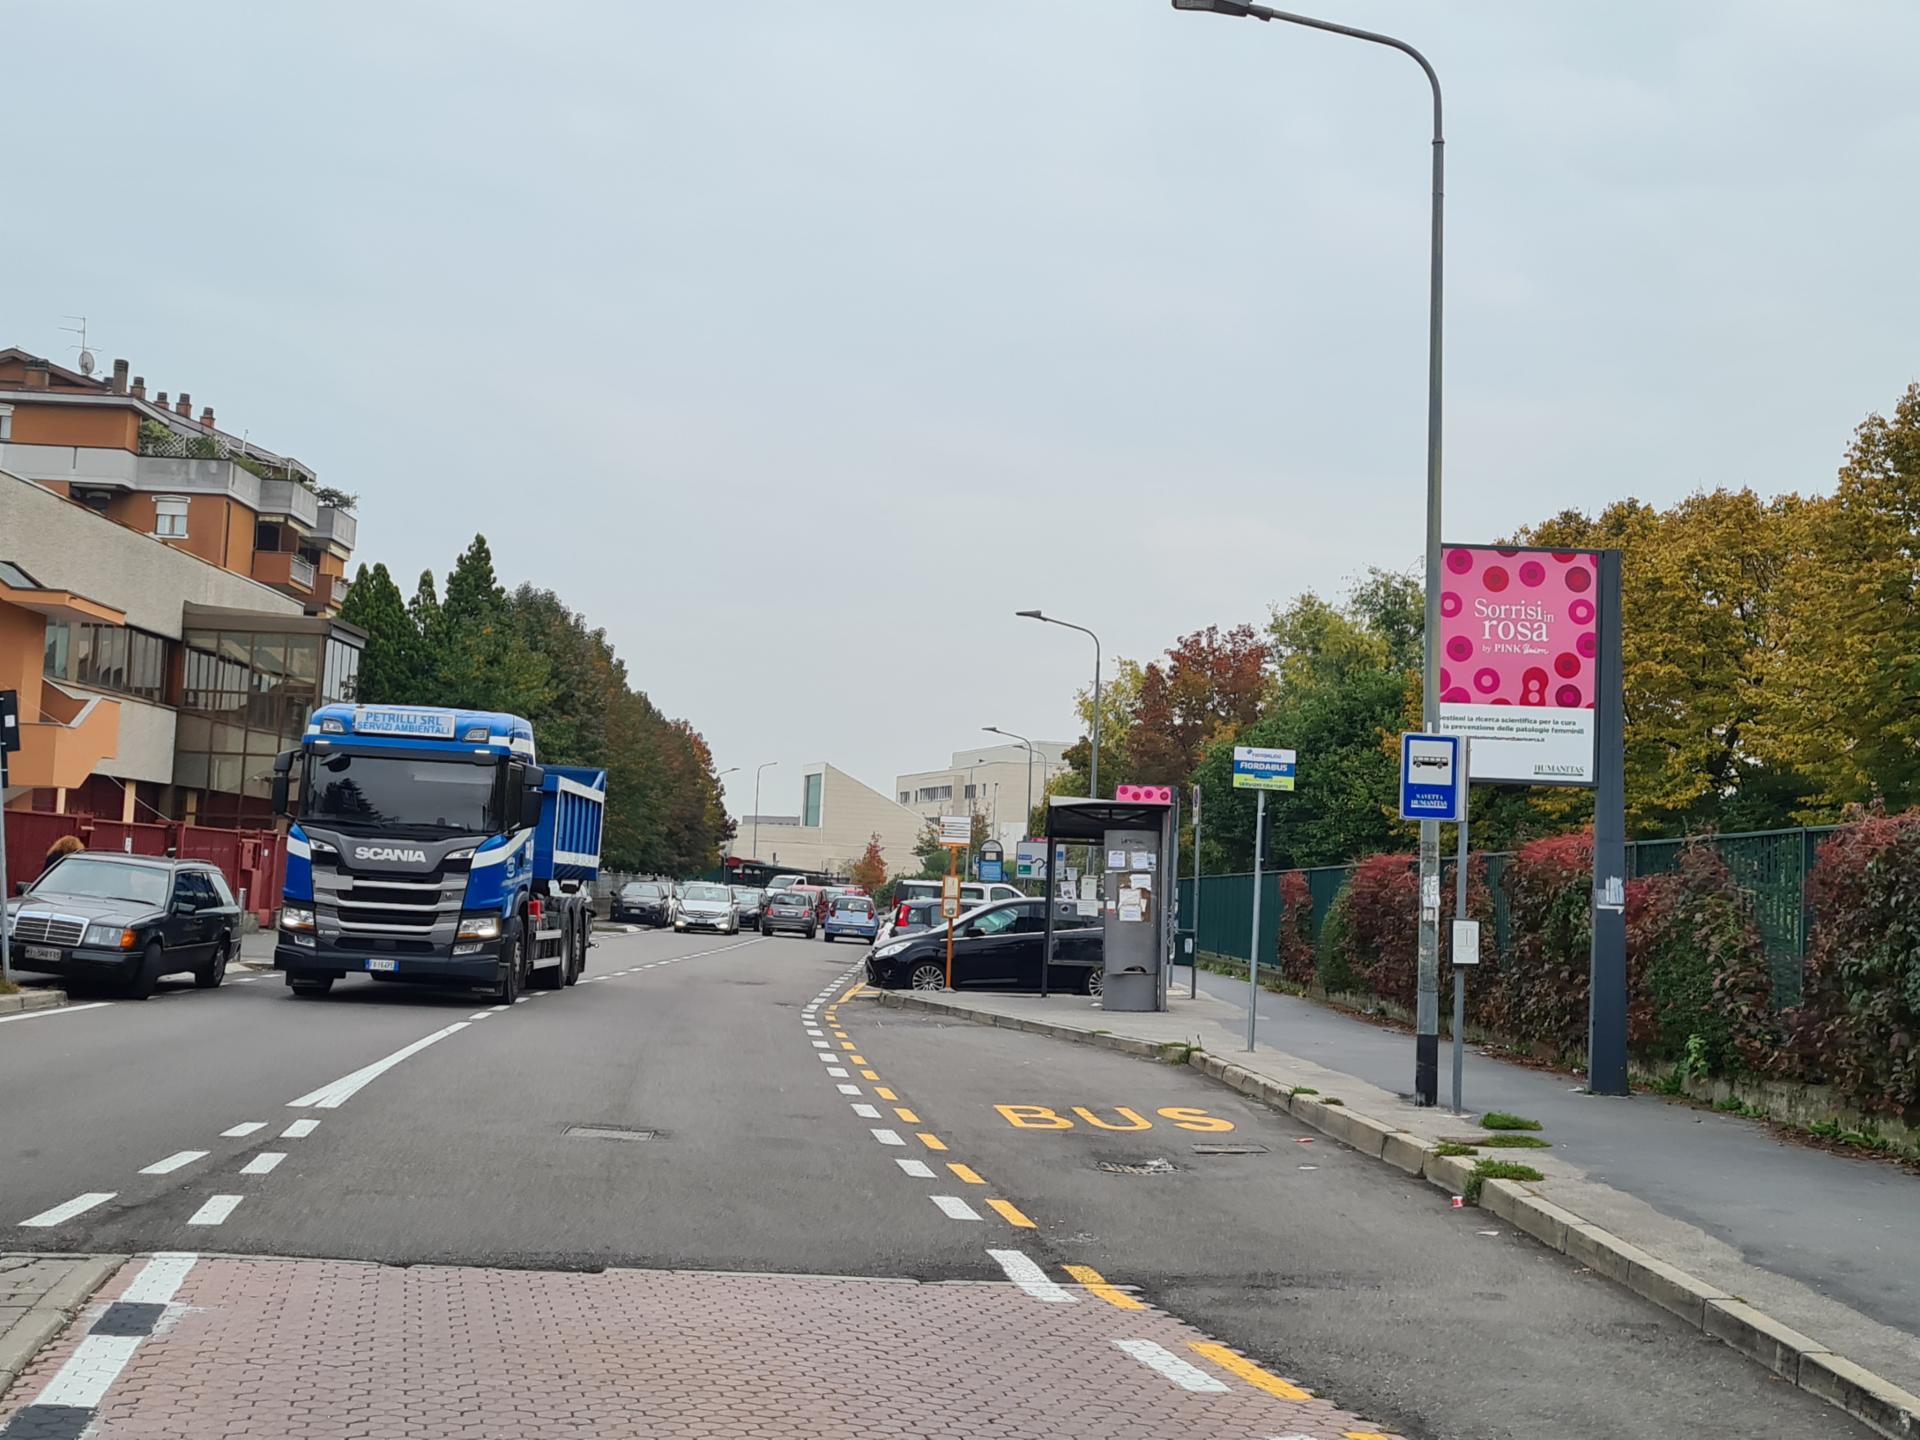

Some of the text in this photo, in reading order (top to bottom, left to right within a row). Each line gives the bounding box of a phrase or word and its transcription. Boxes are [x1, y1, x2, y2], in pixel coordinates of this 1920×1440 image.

[1474, 598, 1554, 623] Sorrisi in
[1482, 619, 1550, 642] rosa
[1482, 644, 1492, 654] by
[1494, 643, 1521, 654] PINK
[365, 711, 443, 727] PETRILLI SRL
[357, 721, 450, 735] SERVIZI AMBIENTALI
[1240, 761, 1288, 772] FIORDABUS
[1534, 764, 1584, 774] HUMANITAS
[1410, 799, 1448, 808] HUMANITAS
[354, 846, 427, 863] SCANIA
[993, 1103, 1236, 1133] BUS
